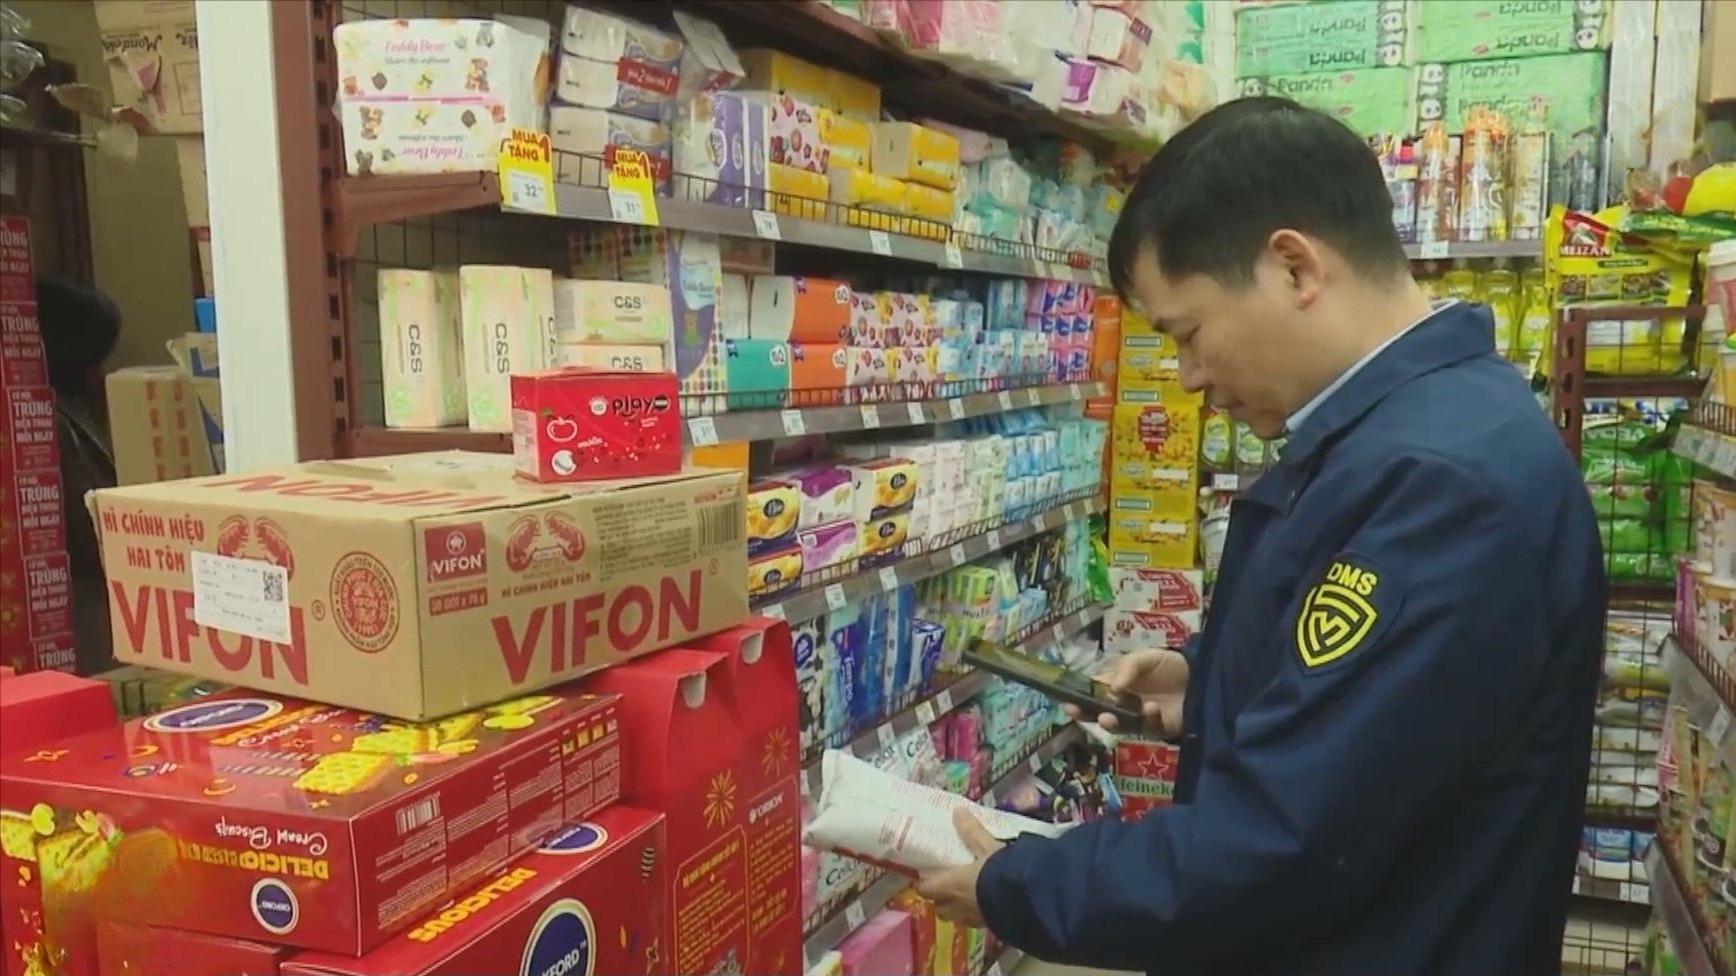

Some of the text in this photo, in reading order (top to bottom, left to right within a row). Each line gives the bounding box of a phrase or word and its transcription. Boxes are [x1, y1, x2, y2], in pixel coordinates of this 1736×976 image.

[1309, 48, 1365, 68] Panda
[1277, 76, 1333, 93] Panda
[512, 129, 538, 144] MUA
[508, 144, 539, 162] TẶNG
[617, 150, 637, 163] MUA
[615, 165, 641, 181] TẶNG
[524, 184, 538, 197] 32
[1560, 245, 1611, 256] MEIZAN
[614, 296, 641, 310] C&S
[408, 324, 422, 373] C&S
[495, 322, 510, 374] C&S
[612, 356, 642, 370] C&S
[613, 395, 653, 417] play
[122, 510, 165, 537] CHÍNH
[169, 514, 204, 545] HIỆU
[127, 545, 185, 573] HAI TÔM
[433, 554, 483, 575] VIFON
[1327, 562, 1377, 596] DMS
[491, 569, 703, 686] VIFON
[843, 656, 855, 702] Tempo
[276, 829, 328, 856] Cream
[408, 867, 537, 942] DELICIOUS
